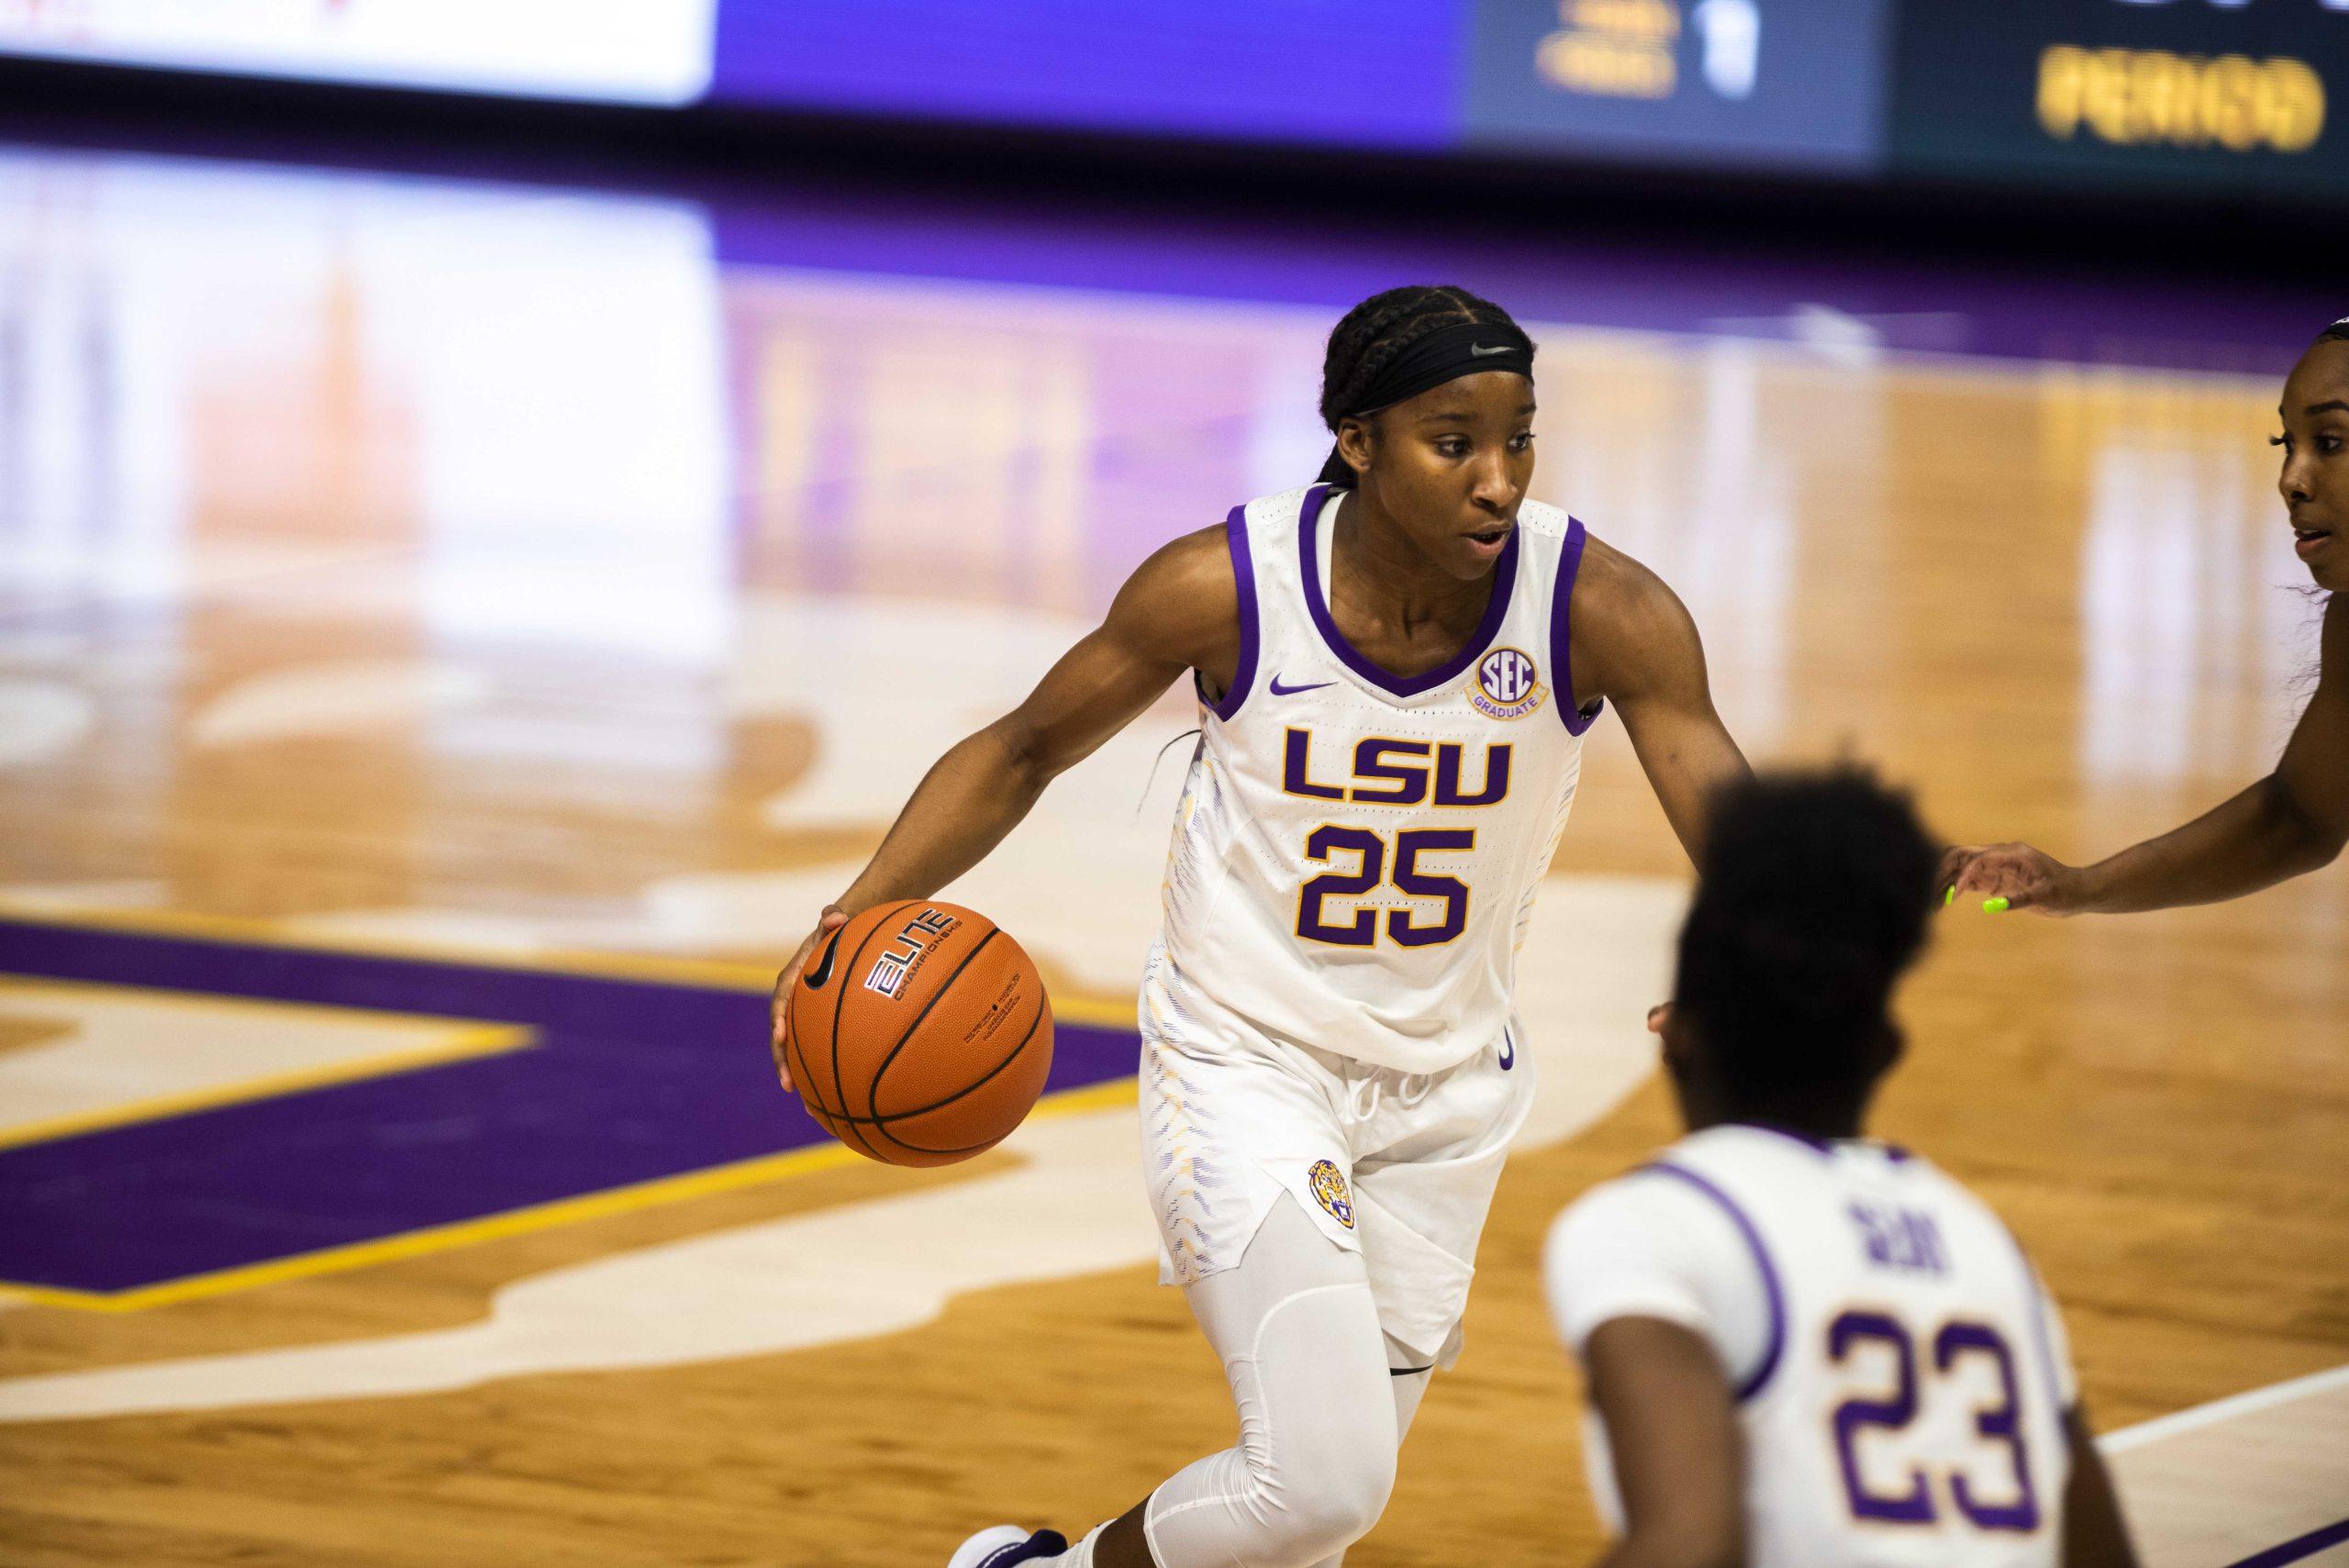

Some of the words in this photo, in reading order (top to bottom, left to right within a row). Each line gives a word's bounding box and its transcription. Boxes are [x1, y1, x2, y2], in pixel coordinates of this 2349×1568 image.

[2037, 44, 2325, 153] PERIOD
[1474, 695, 1538, 717] GRADUATE
[1481, 651, 1532, 700] SEC
[1284, 726, 1513, 807] LSU
[1296, 822, 1477, 949] 25
[864, 907, 956, 998] ELITE
[894, 920, 963, 1001] CHAMPIONSHIP
[1825, 1311, 2041, 1533] 23
